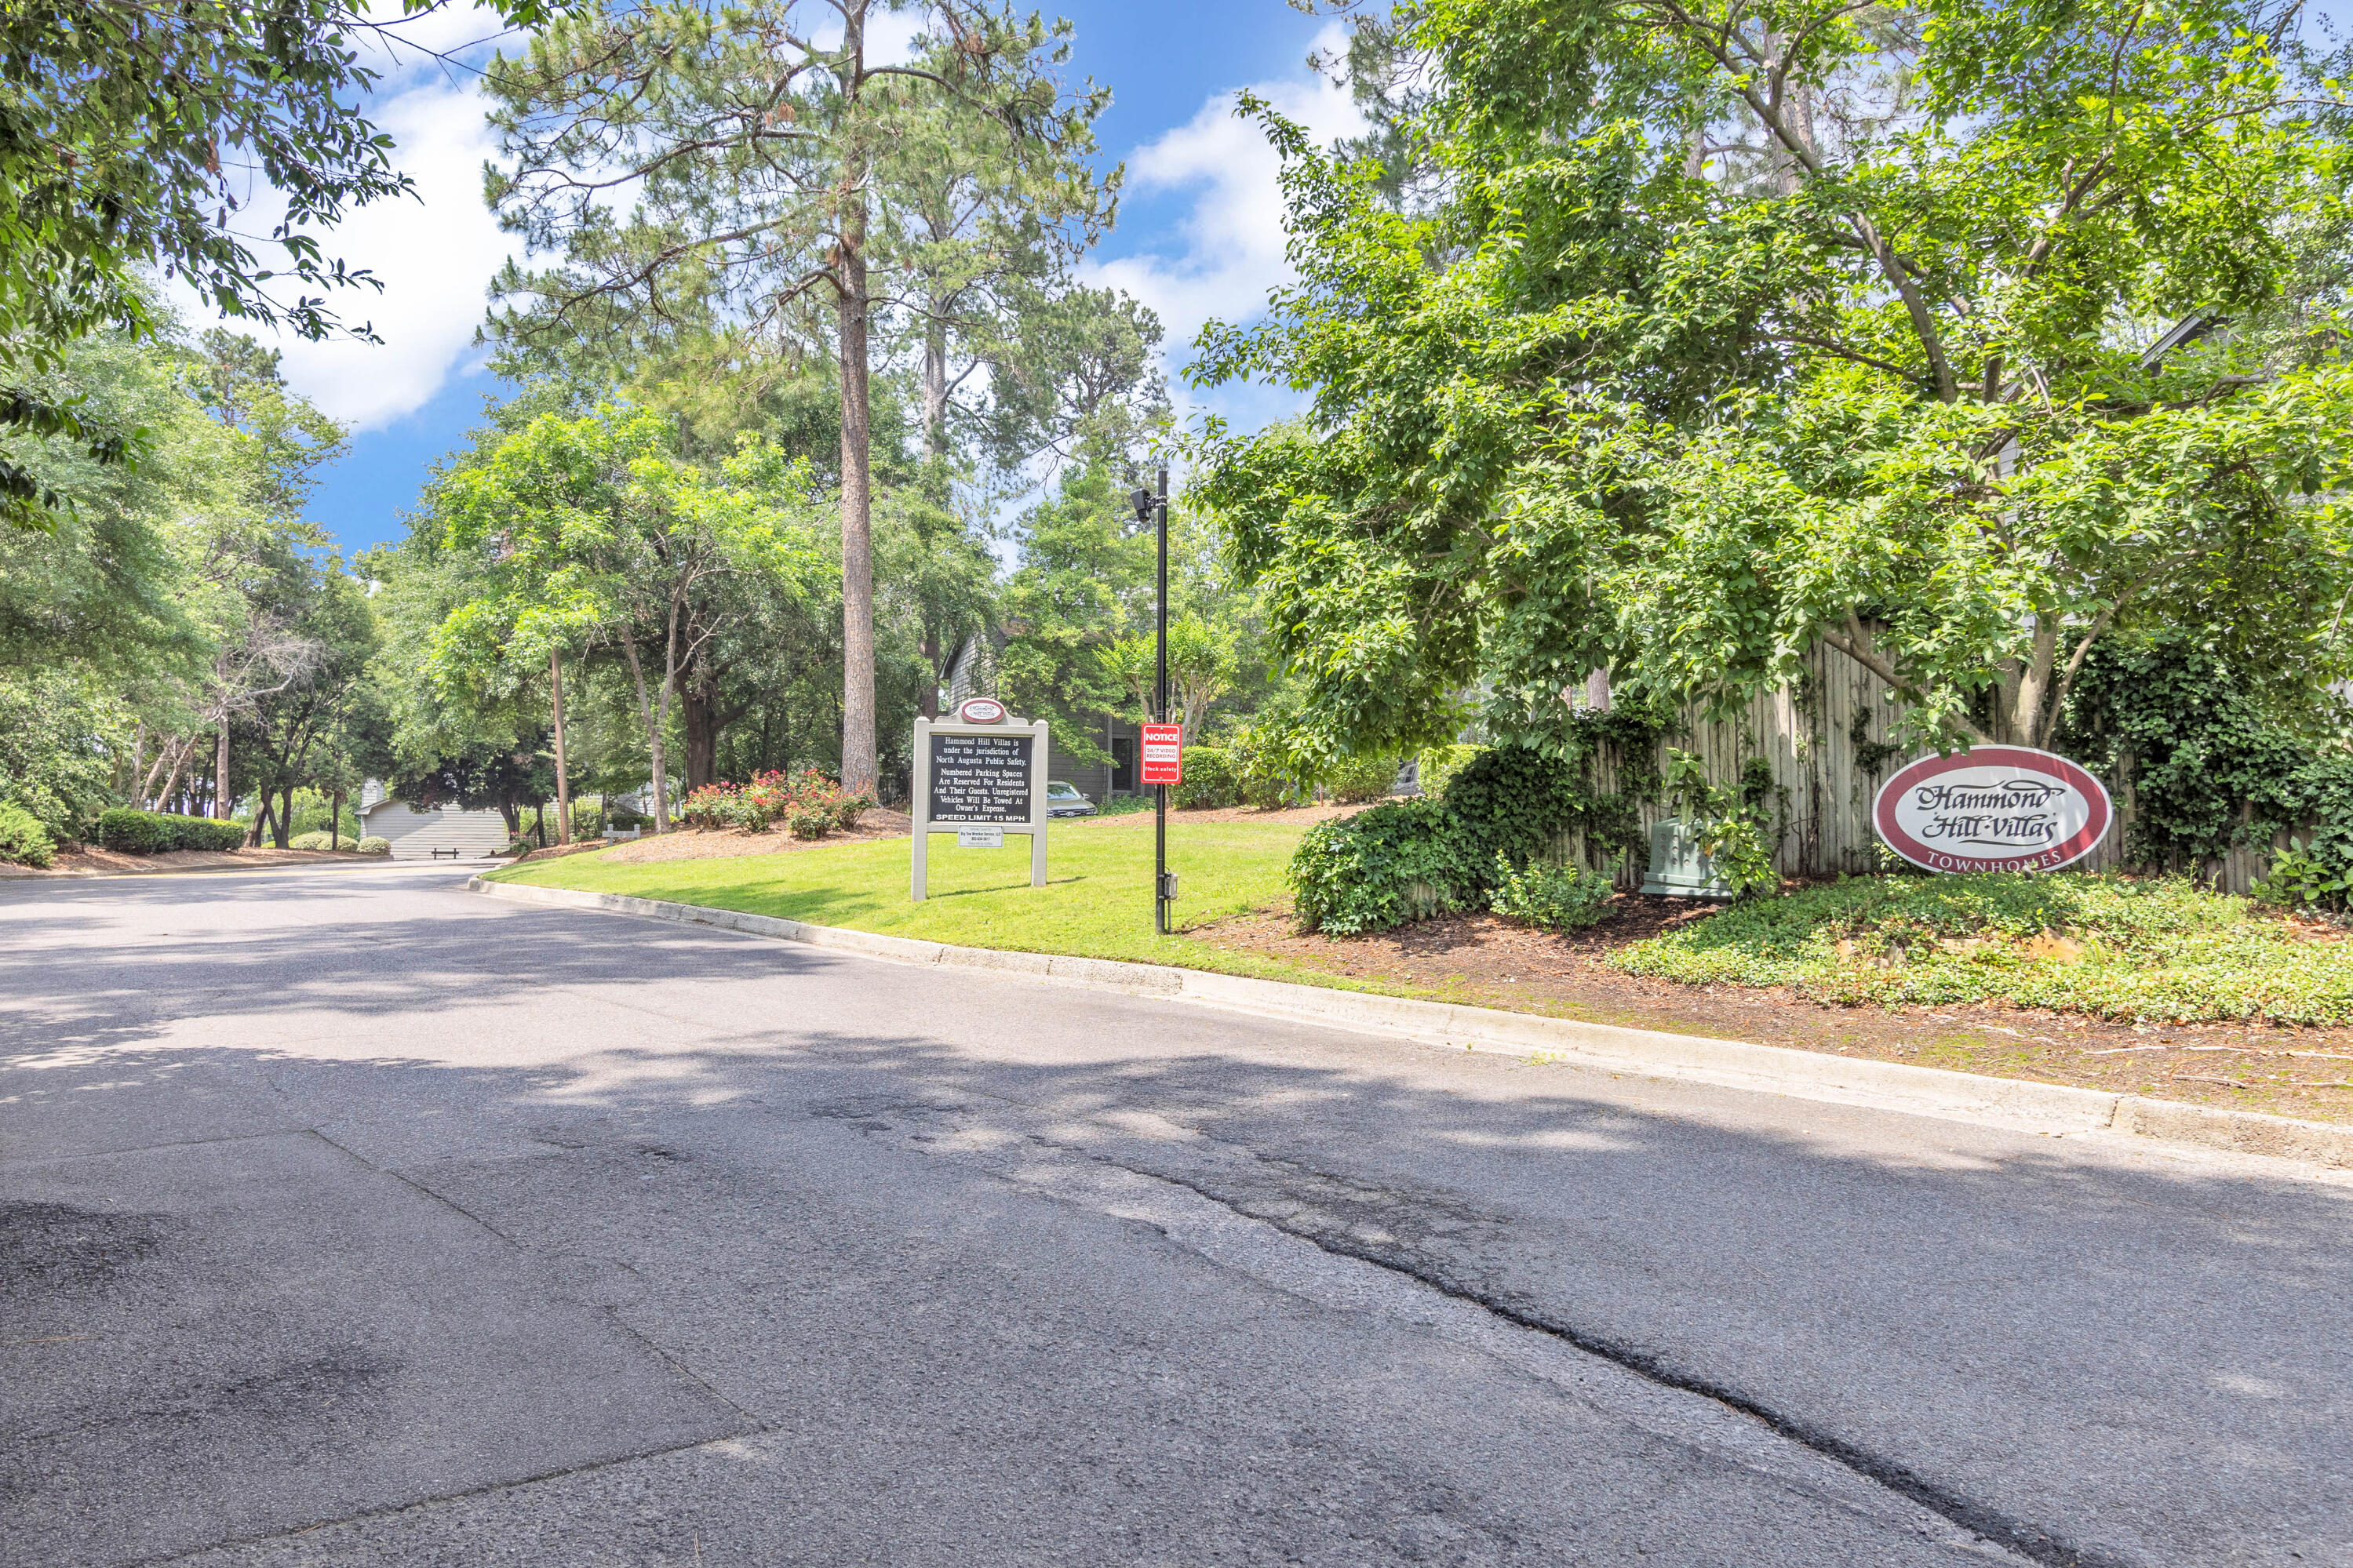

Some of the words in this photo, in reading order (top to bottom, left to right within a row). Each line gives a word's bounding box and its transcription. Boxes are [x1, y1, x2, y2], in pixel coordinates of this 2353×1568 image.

[945, 737, 974, 745] Hammond
[978, 737, 990, 746] Hill
[975, 747, 1010, 755] jurisdiction
[936, 755, 954, 764] North
[957, 756, 982, 765] Augusta
[1007, 758, 1026, 766] Safety.
[975, 769, 1000, 778] Parking
[1002, 769, 1023, 778] Spaces
[996, 778, 1025, 787] Residents
[968, 787, 989, 795] Guests.
[992, 788, 1029, 796] Unregistered
[1916, 780, 2066, 810] Hammond
[993, 796, 1012, 805] Towed
[982, 804, 1007, 813] Expense.
